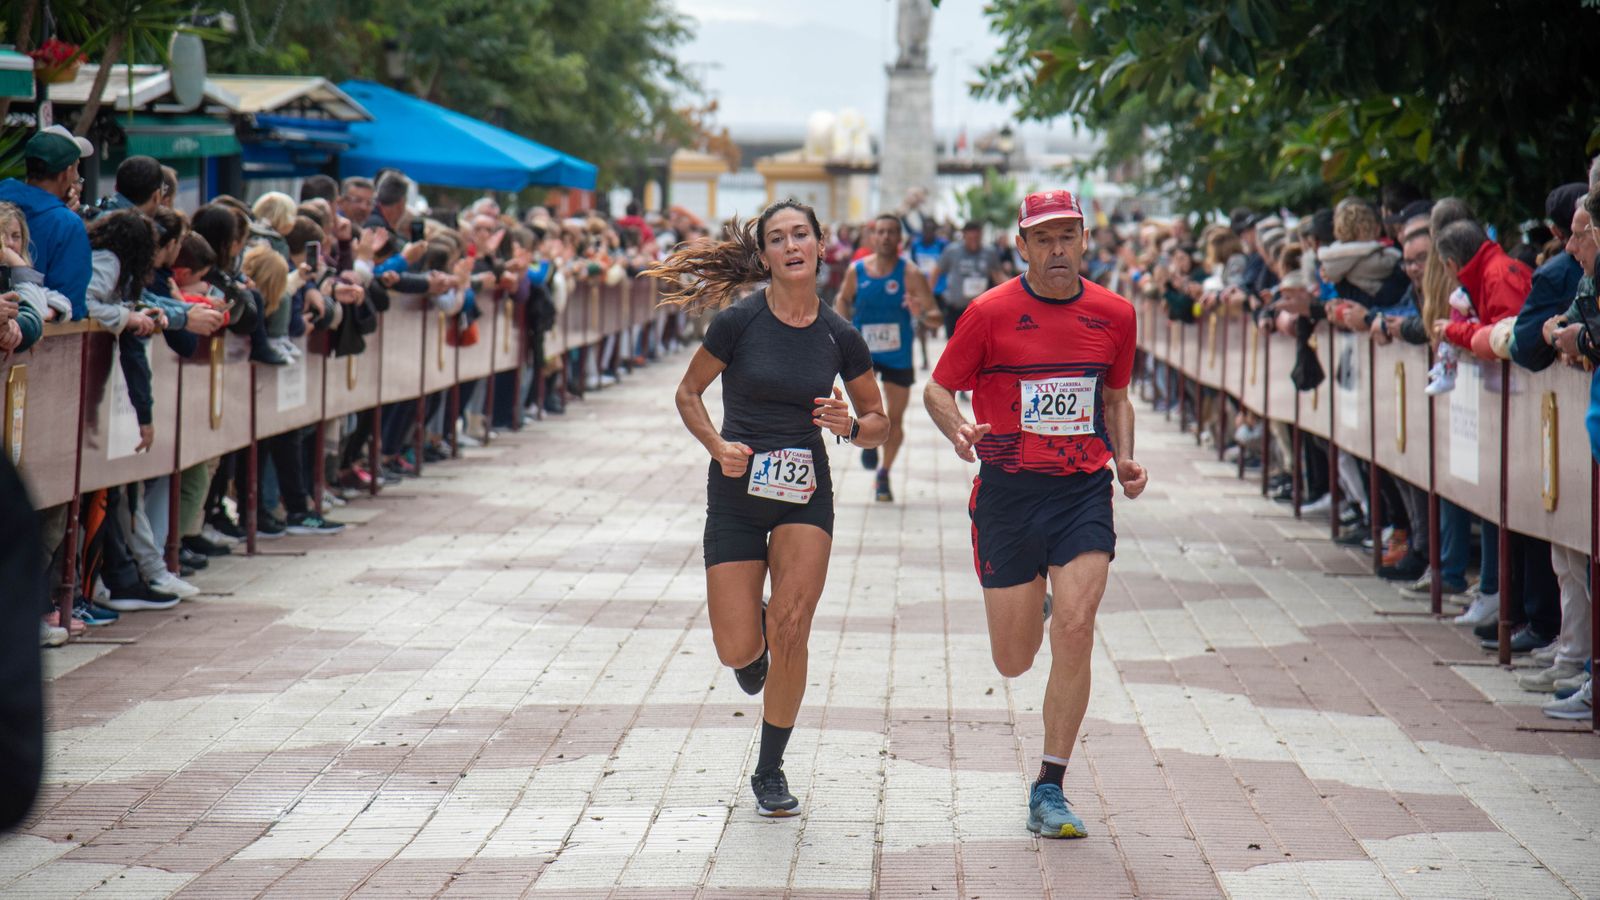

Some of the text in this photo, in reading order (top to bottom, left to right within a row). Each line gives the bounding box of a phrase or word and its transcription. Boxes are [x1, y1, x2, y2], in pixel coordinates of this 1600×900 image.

[1034, 383, 1058, 393] XIV
[1041, 393, 1077, 416] 262
[773, 459, 809, 485] 132
